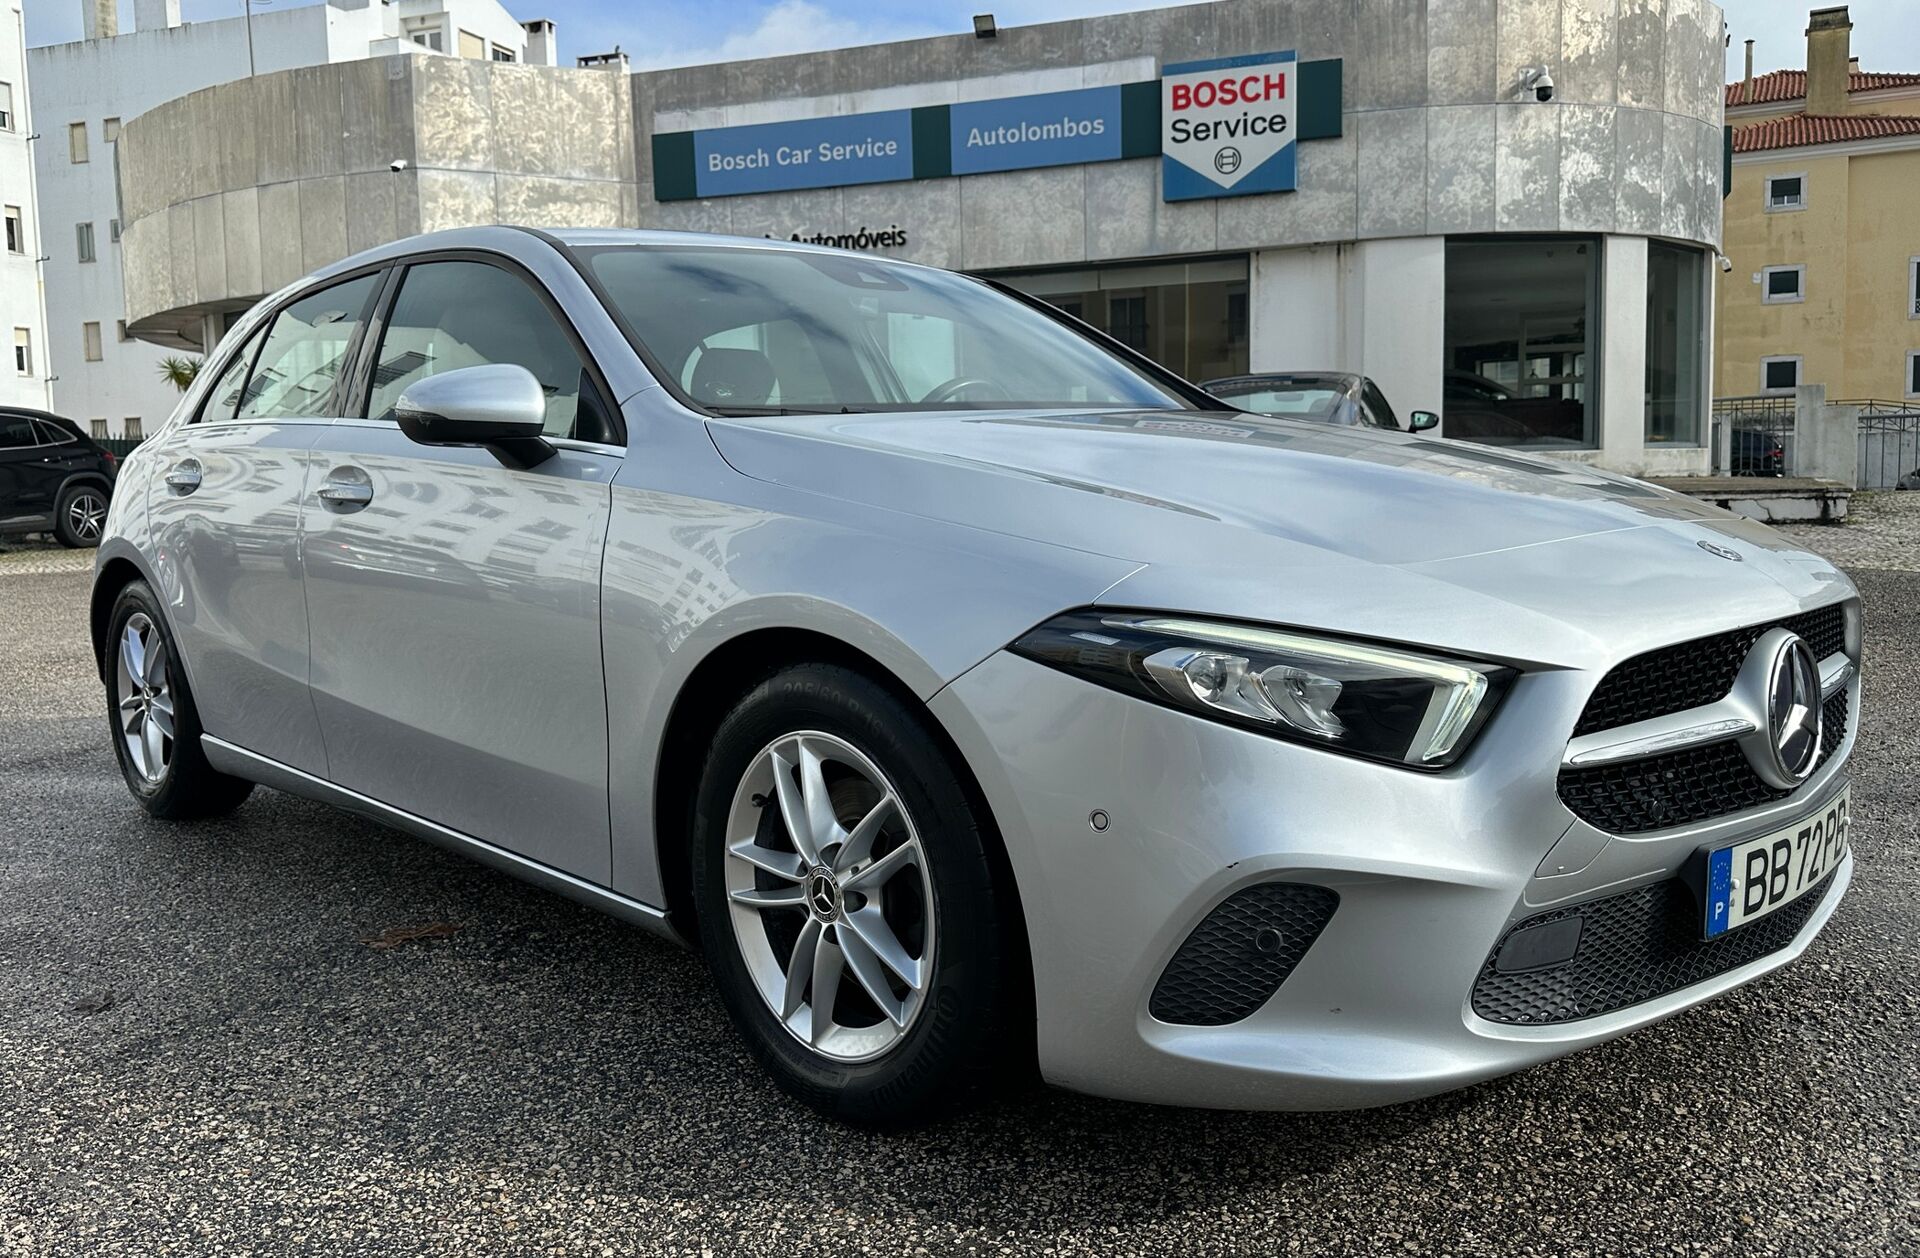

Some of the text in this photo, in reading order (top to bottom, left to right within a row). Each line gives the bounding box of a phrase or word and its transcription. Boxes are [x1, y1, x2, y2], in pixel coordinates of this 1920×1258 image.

[1172, 72, 1285, 112] BOSCH
[966, 116, 1105, 148] Autolombos
[1171, 111, 1287, 144] Service
[708, 137, 898, 172] Bosch Car Service
[1714, 902, 1724, 921] P
